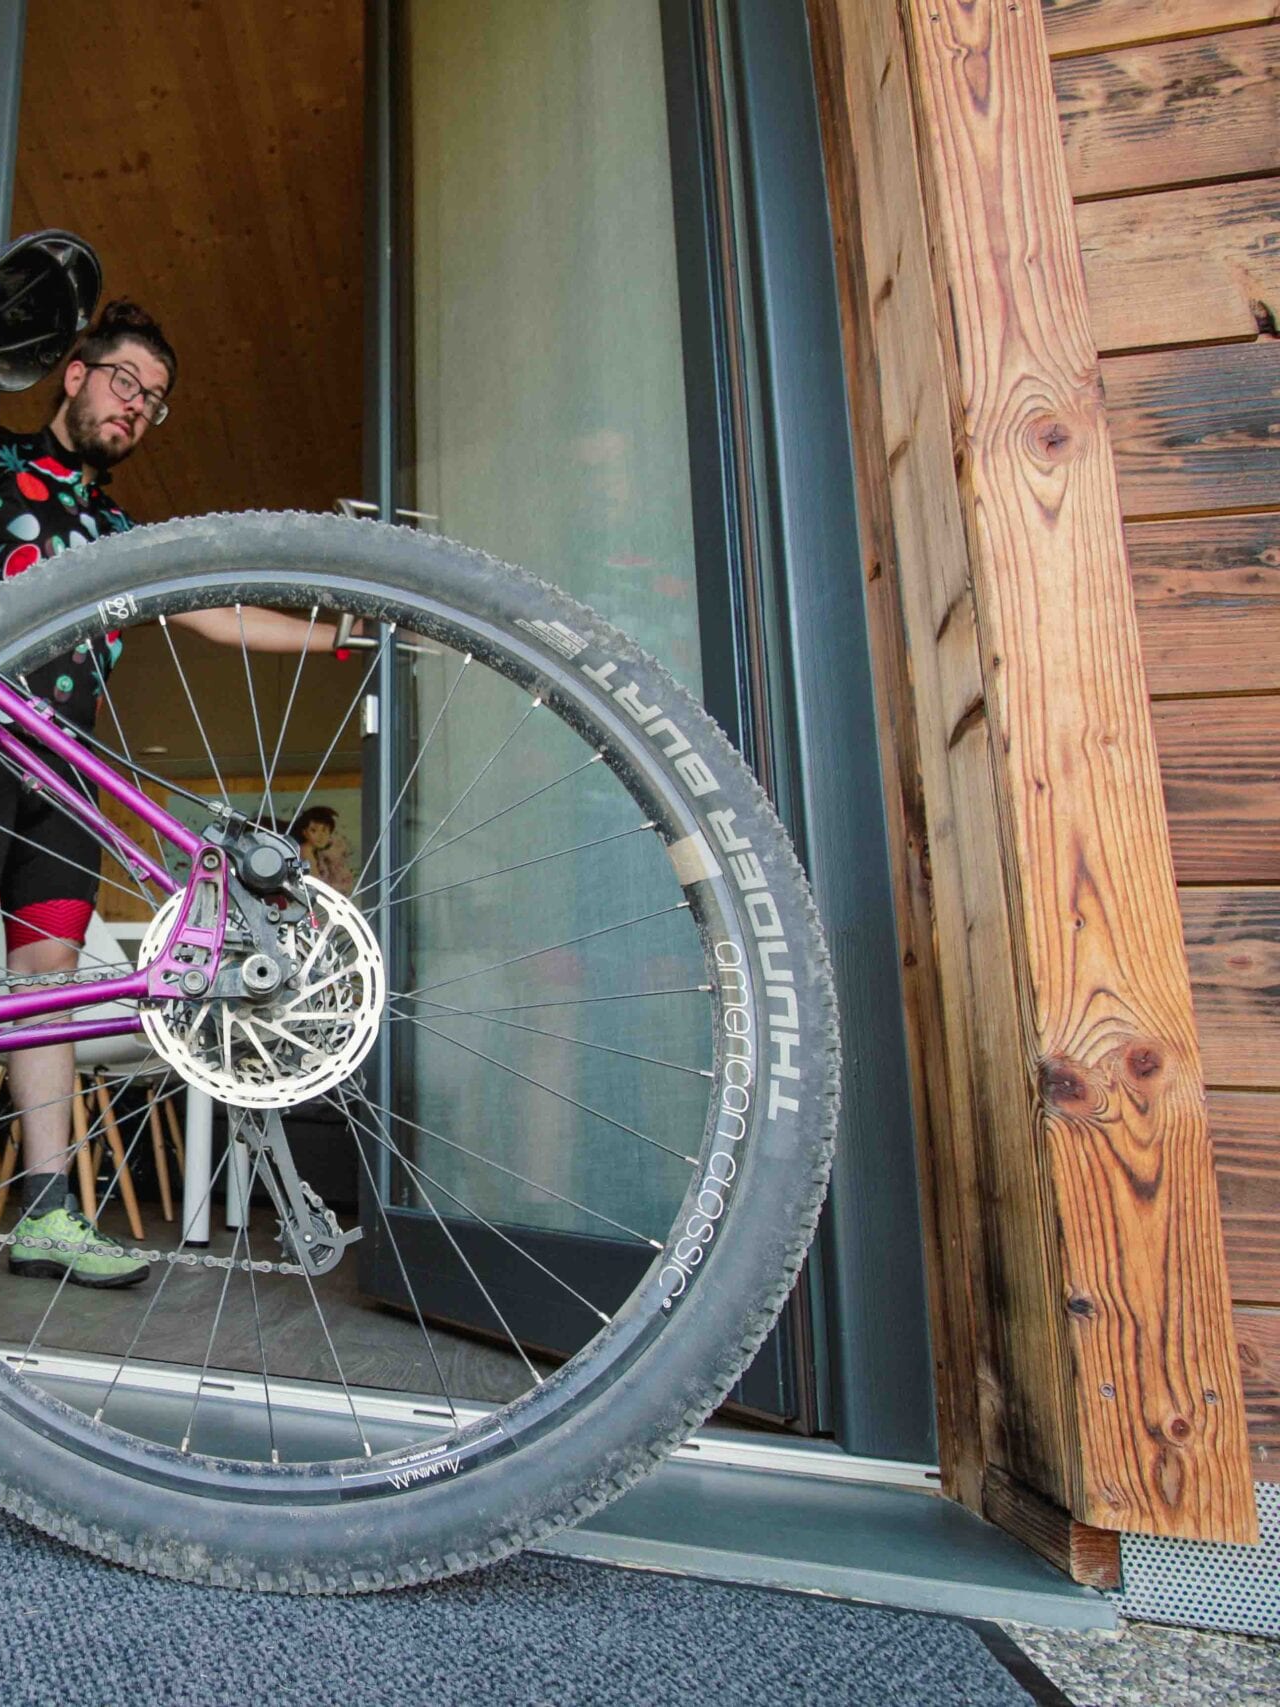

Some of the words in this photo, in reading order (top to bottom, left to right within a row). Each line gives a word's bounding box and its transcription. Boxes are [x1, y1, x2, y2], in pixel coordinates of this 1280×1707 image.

[580, 661, 721, 798] BURT
[706, 807, 801, 1121] THUNDER
[714, 941, 752, 1141] american
